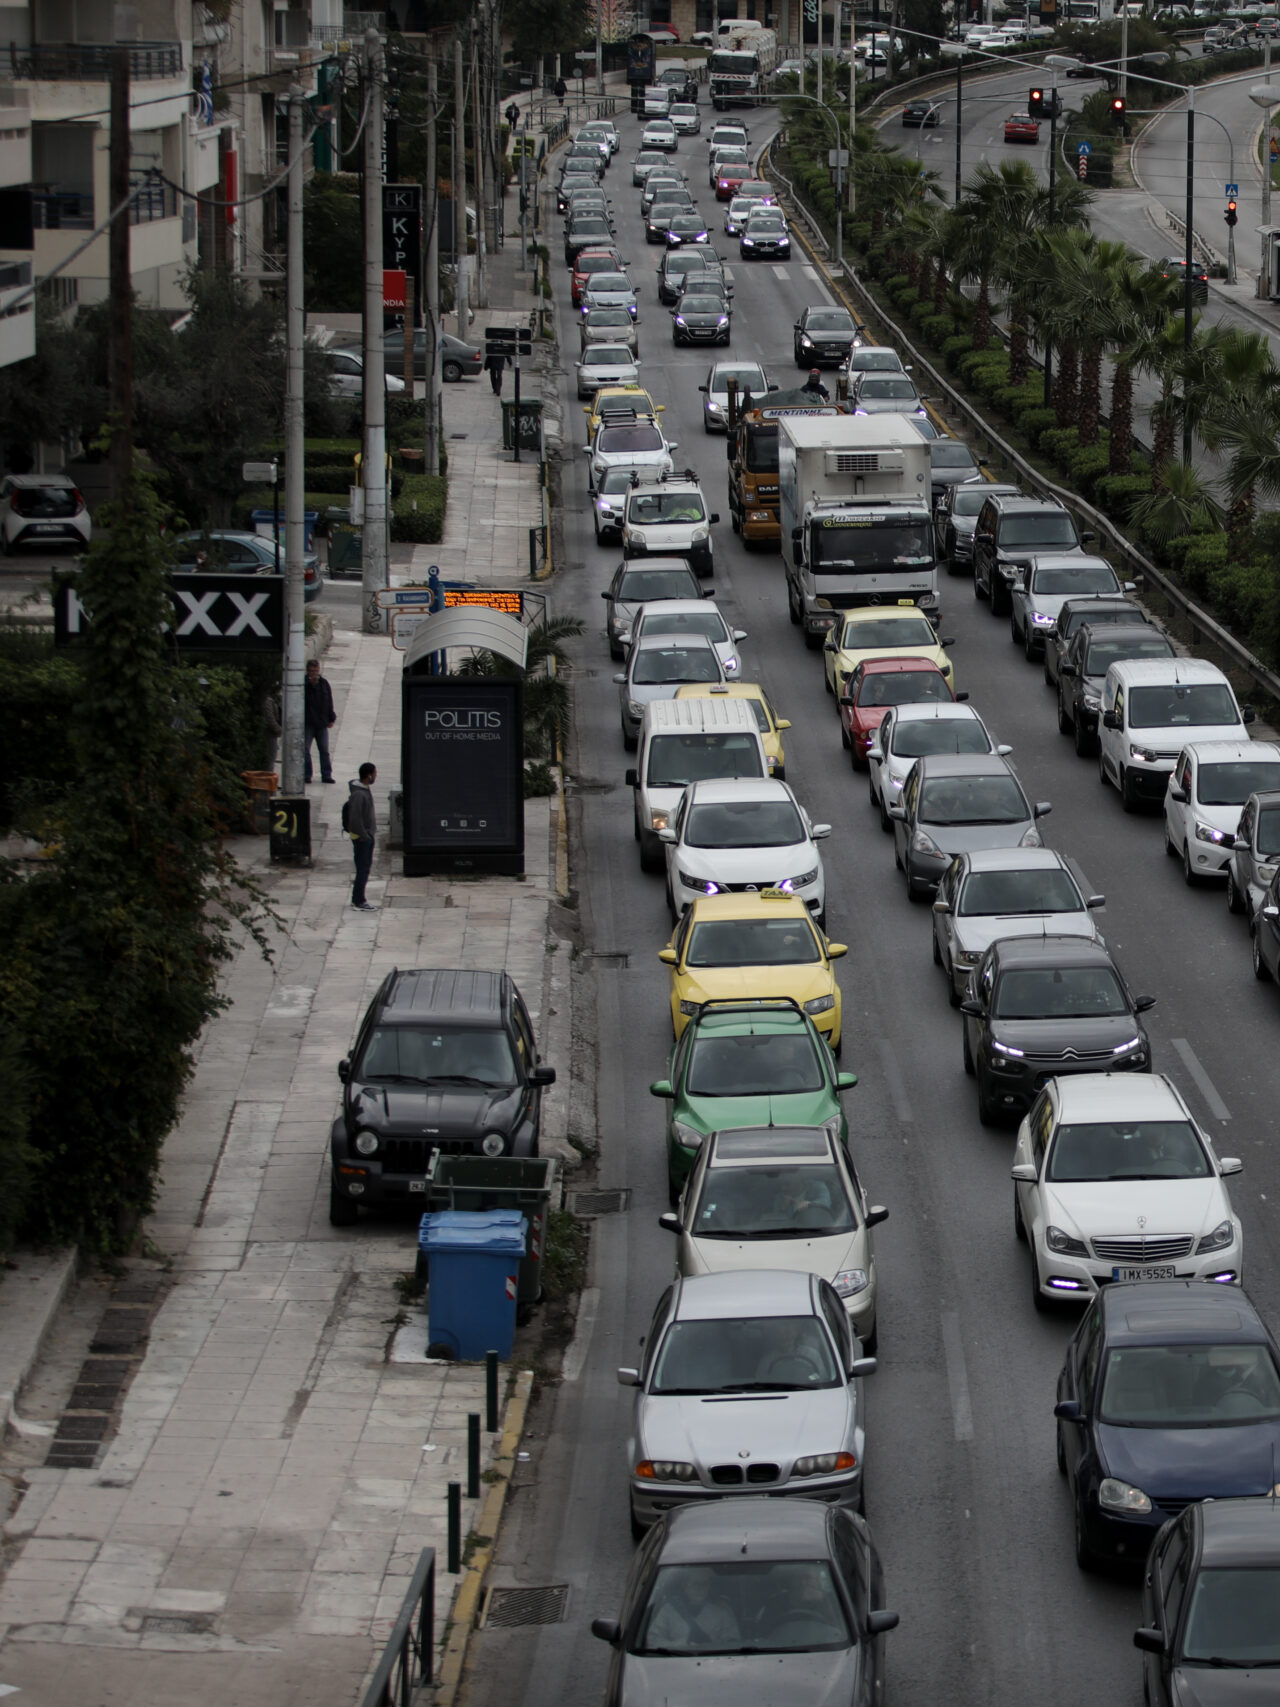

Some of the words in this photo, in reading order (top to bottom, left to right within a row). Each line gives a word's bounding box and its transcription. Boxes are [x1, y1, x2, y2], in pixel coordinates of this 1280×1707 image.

[67, 588, 273, 637] XX
[425, 710, 502, 728] POLITIS
[425, 732, 440, 740] OUT
[442, 732, 452, 740] OF
[453, 732, 475, 740] HOME
[477, 732, 501, 741] MEDIA
[273, 810, 298, 838] 21
[764, 889, 790, 897] TAXI
